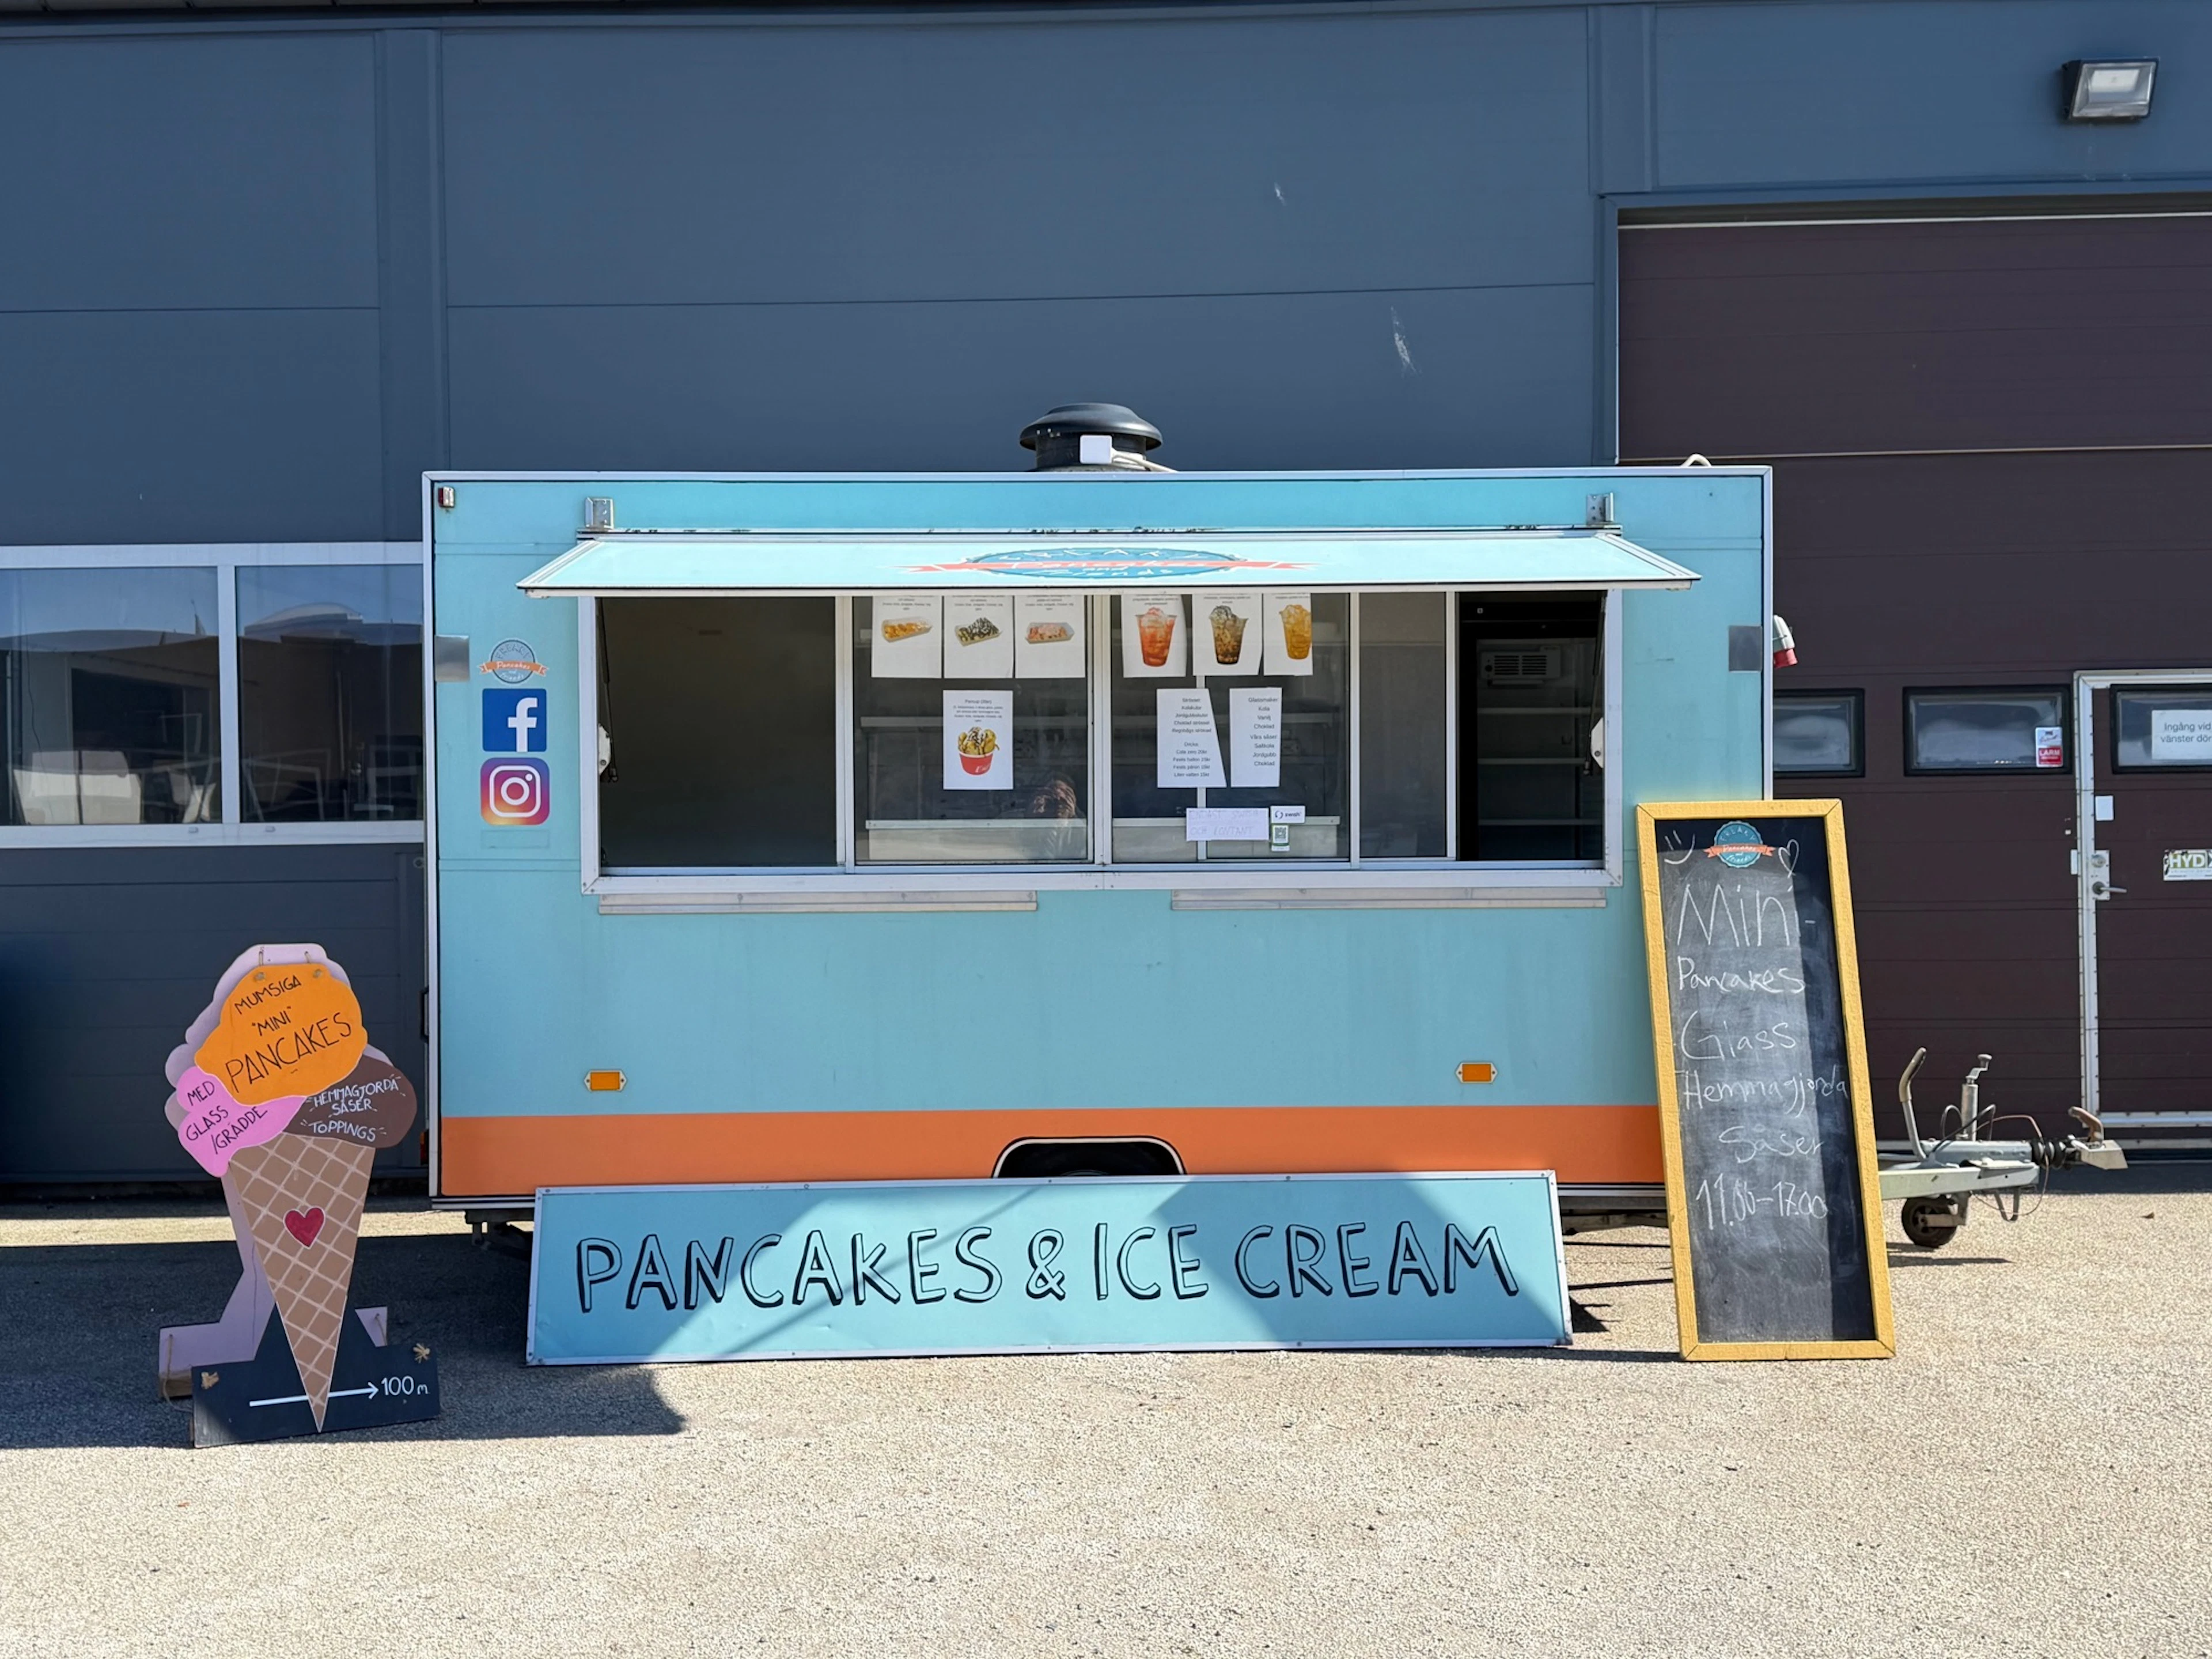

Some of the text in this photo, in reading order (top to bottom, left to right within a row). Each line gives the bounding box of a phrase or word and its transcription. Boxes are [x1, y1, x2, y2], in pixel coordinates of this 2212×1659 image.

[497, 661, 531, 669] Pancakes
[2160, 734, 2195, 743] vänster
[2164, 721, 2211, 733] Ingång vid
[1677, 955, 1806, 994] Pancakes
[234, 975, 302, 1015] MUMSIGA
[225, 1012, 351, 1093] PANCAKES
[1680, 1010, 1797, 1062] Glass
[187, 1081, 215, 1106] MED
[313, 1079, 399, 1107] HEMMAGJORDA
[1681, 1064, 1849, 1119] Hemmagjorda
[186, 1105, 228, 1141] GLASS
[308, 1120, 376, 1142] TOPPINGS
[1718, 1124, 1824, 1164] Såser
[575, 1221, 1520, 1313] PANCAKES & ICE CREAM
[380, 1375, 415, 1396] 100
